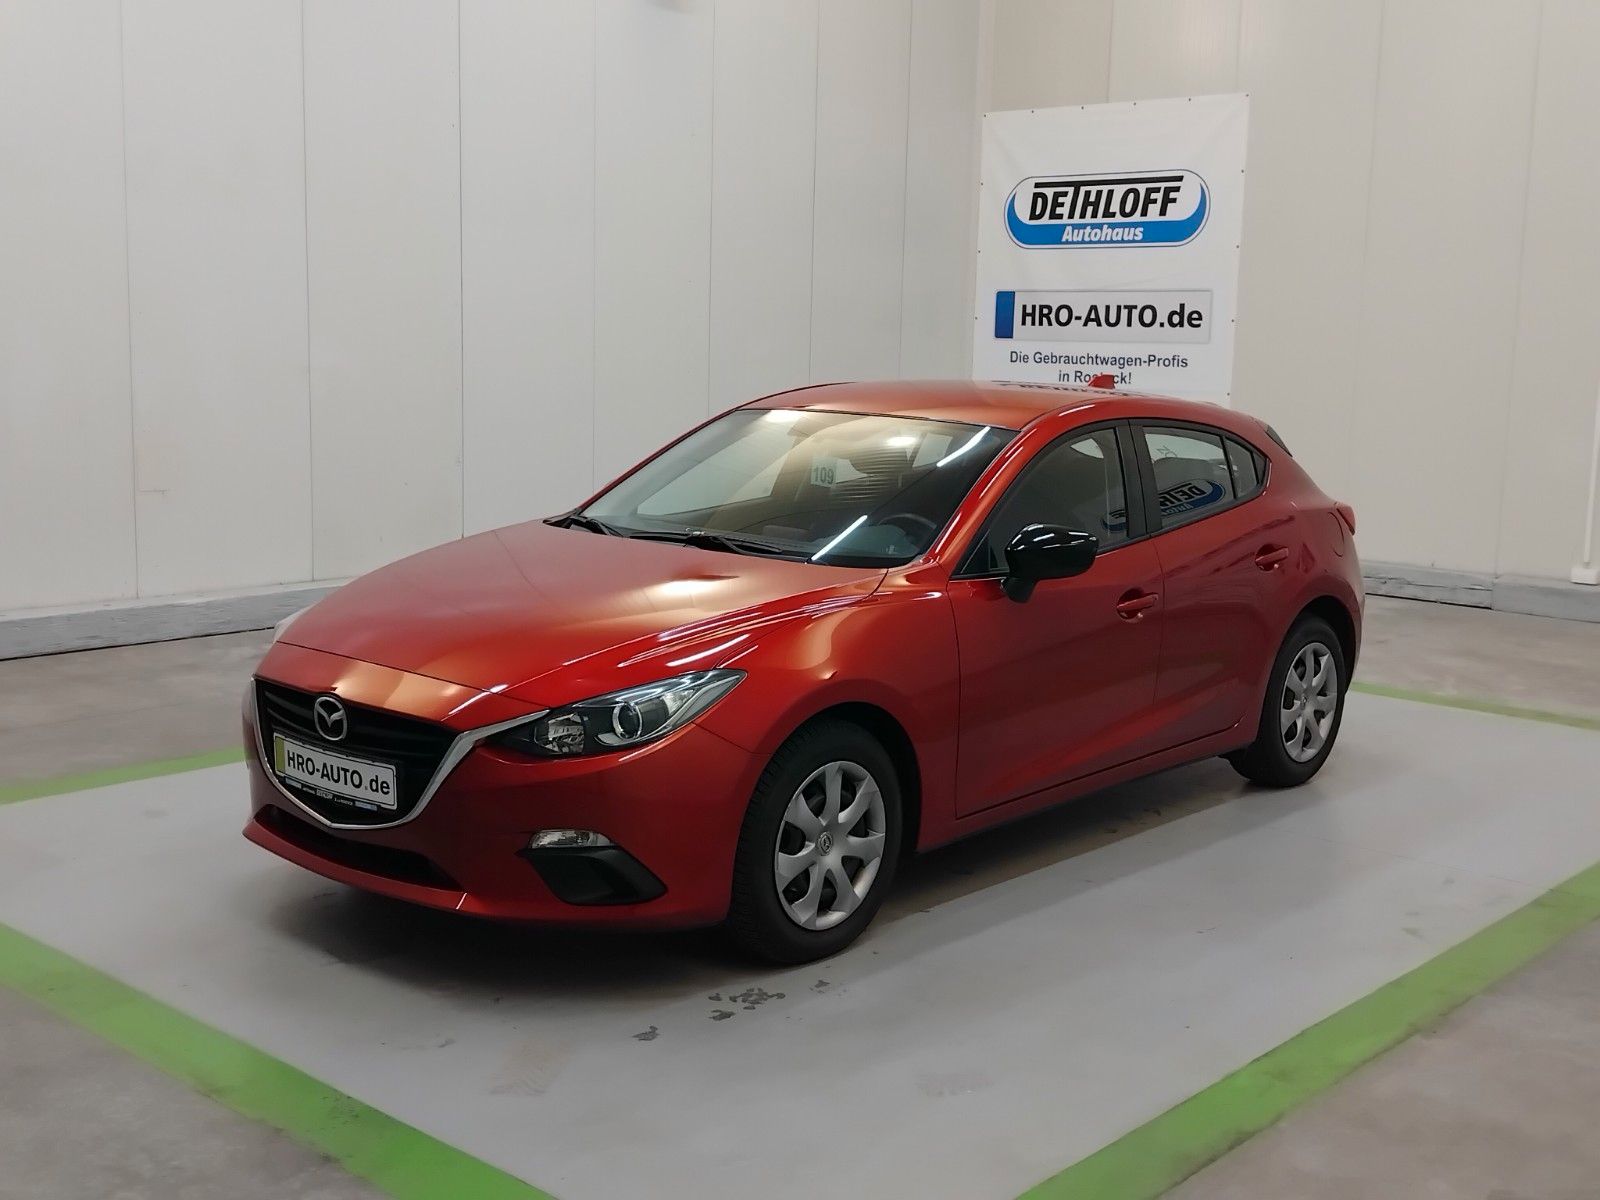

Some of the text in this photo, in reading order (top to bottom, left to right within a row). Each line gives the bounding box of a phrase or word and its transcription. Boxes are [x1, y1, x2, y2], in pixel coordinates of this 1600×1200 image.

[1028, 175, 1184, 221] DETHLOFF
[1061, 225, 1144, 242] Autohaus
[1020, 303, 1203, 328] HRO-AUTO.de
[1009, 351, 1189, 369] Die Gebrauchtwagen-Profis
[1058, 370, 1132, 384] in Rock!
[814, 466, 835, 485] 109
[287, 749, 390, 795] HRO-AUTO.de
